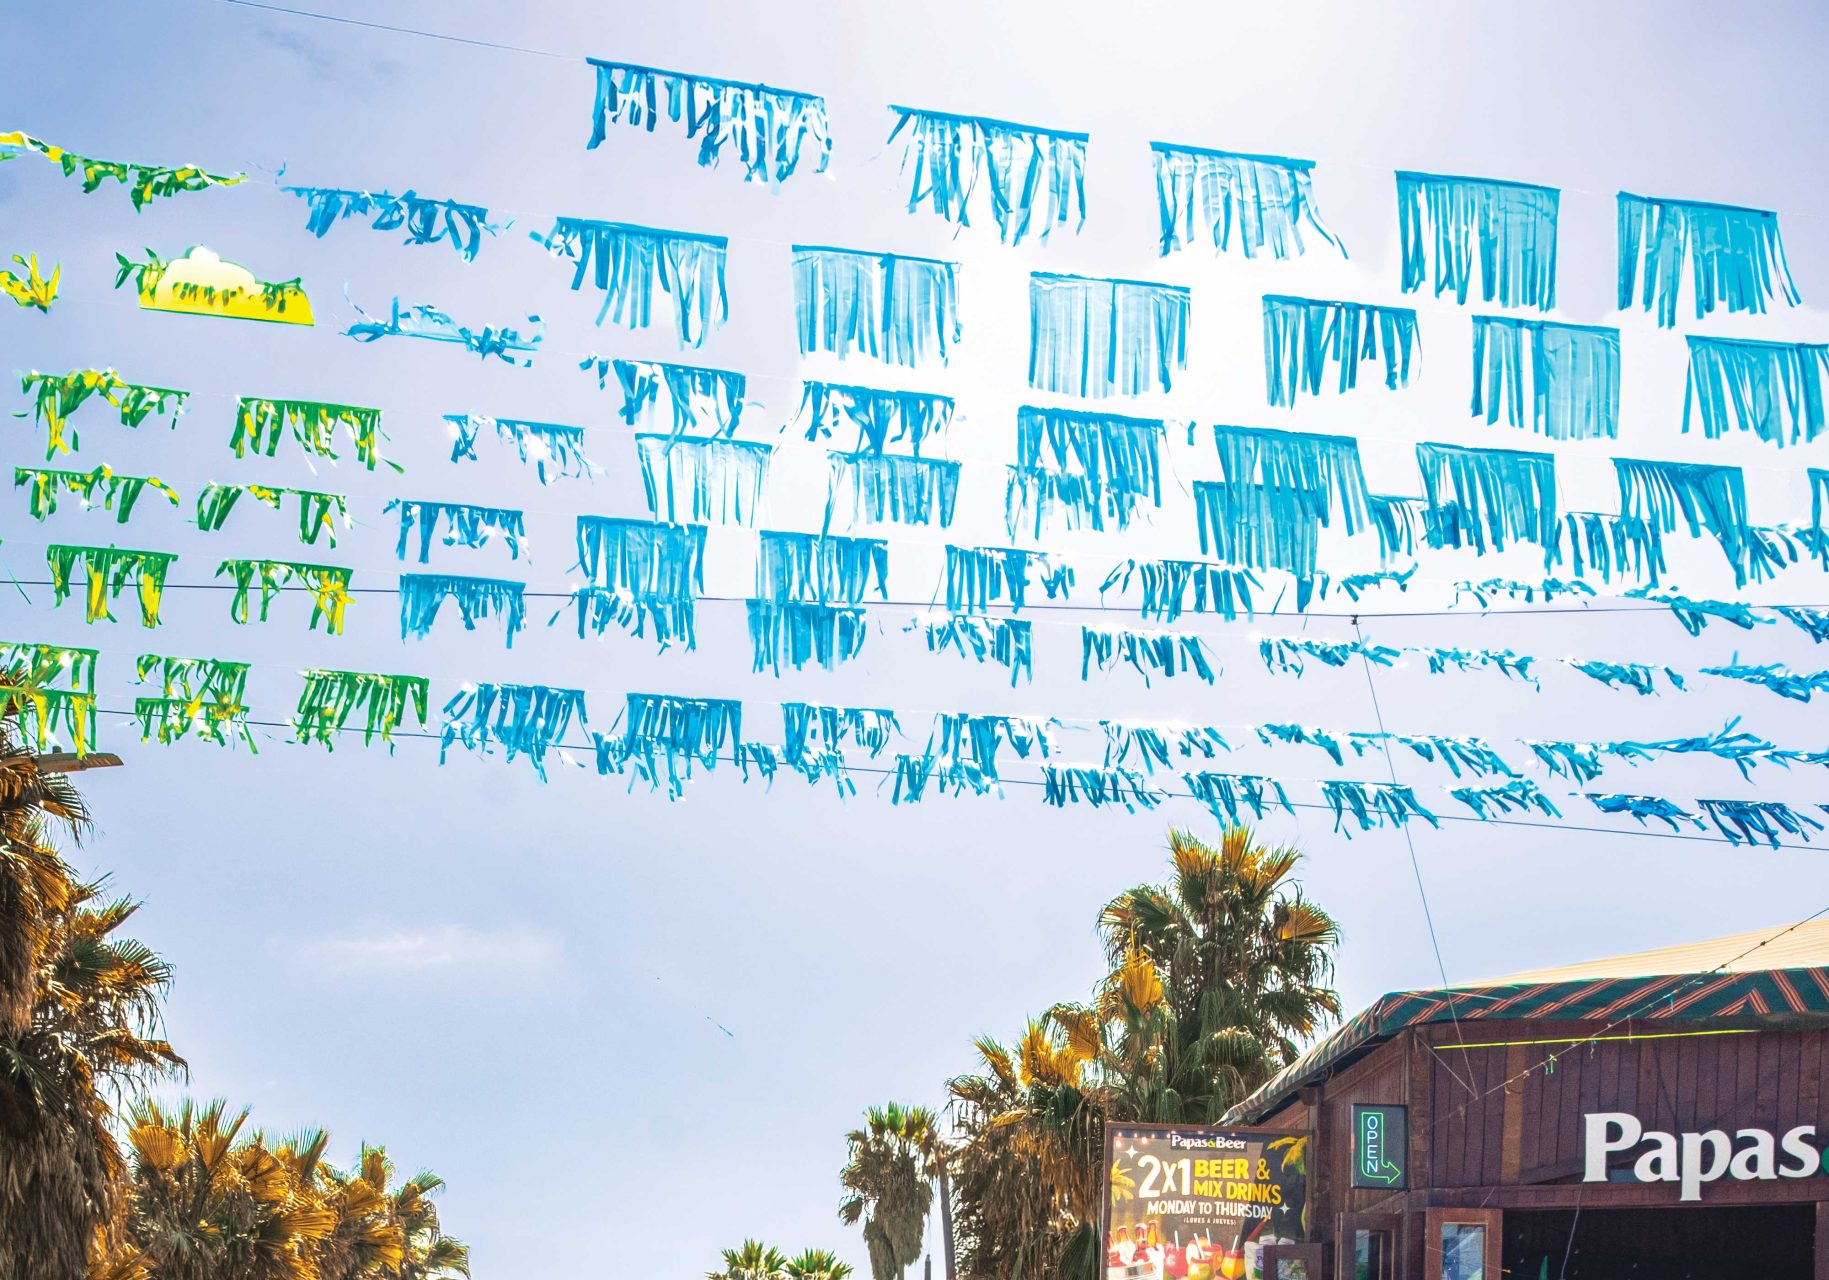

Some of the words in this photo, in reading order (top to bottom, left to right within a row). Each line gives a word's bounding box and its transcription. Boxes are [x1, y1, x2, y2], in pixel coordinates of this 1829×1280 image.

[1171, 1134, 1247, 1150] Papas&Beer
[1366, 1115, 1379, 1174] OPEN
[1582, 1111, 1821, 1201] Papas
[1194, 1158, 1249, 1180] BEER
[1256, 1157, 1270, 1180] &
[1193, 1180, 1224, 1198] MIX
[1226, 1182, 1282, 1205] DRINKS
[1147, 1200, 1197, 1215] MONDAY
[1199, 1202, 1212, 1215] TO
[1214, 1202, 1273, 1220] THURSDAY
